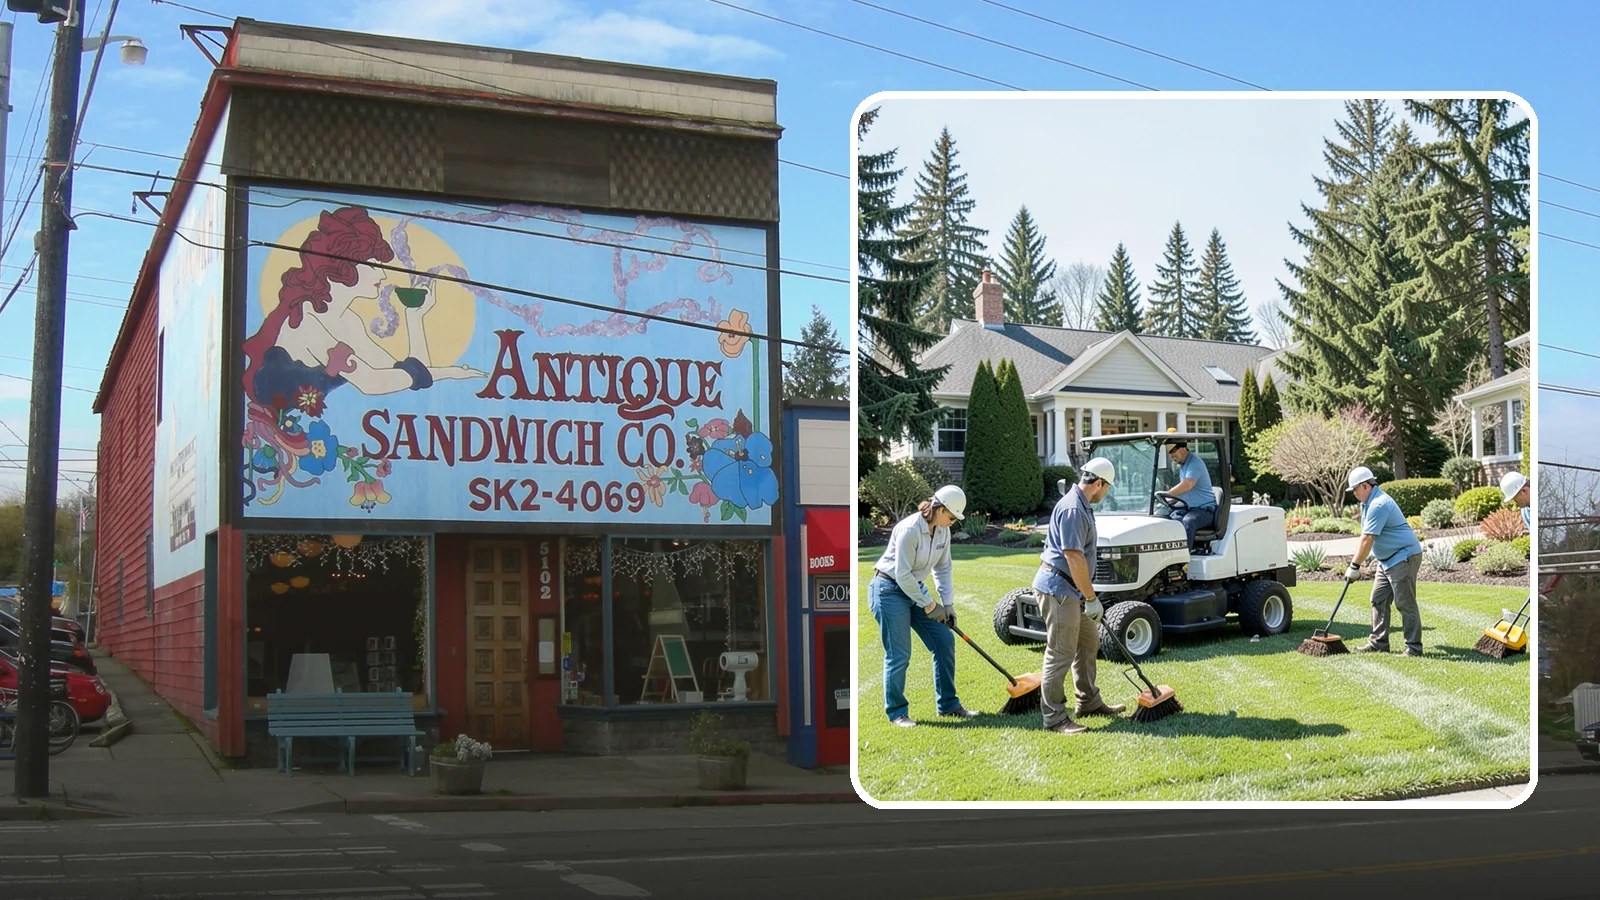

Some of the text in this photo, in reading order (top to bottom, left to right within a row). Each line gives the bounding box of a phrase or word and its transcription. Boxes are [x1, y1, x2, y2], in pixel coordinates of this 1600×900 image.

[476, 329, 723, 421] ANTIQUE
[361, 408, 685, 469] SANDWICH CO.
[468, 477, 646, 513] SK2-4069
[540, 541, 551, 599] 5102
[809, 555, 835, 569] BOOKS
